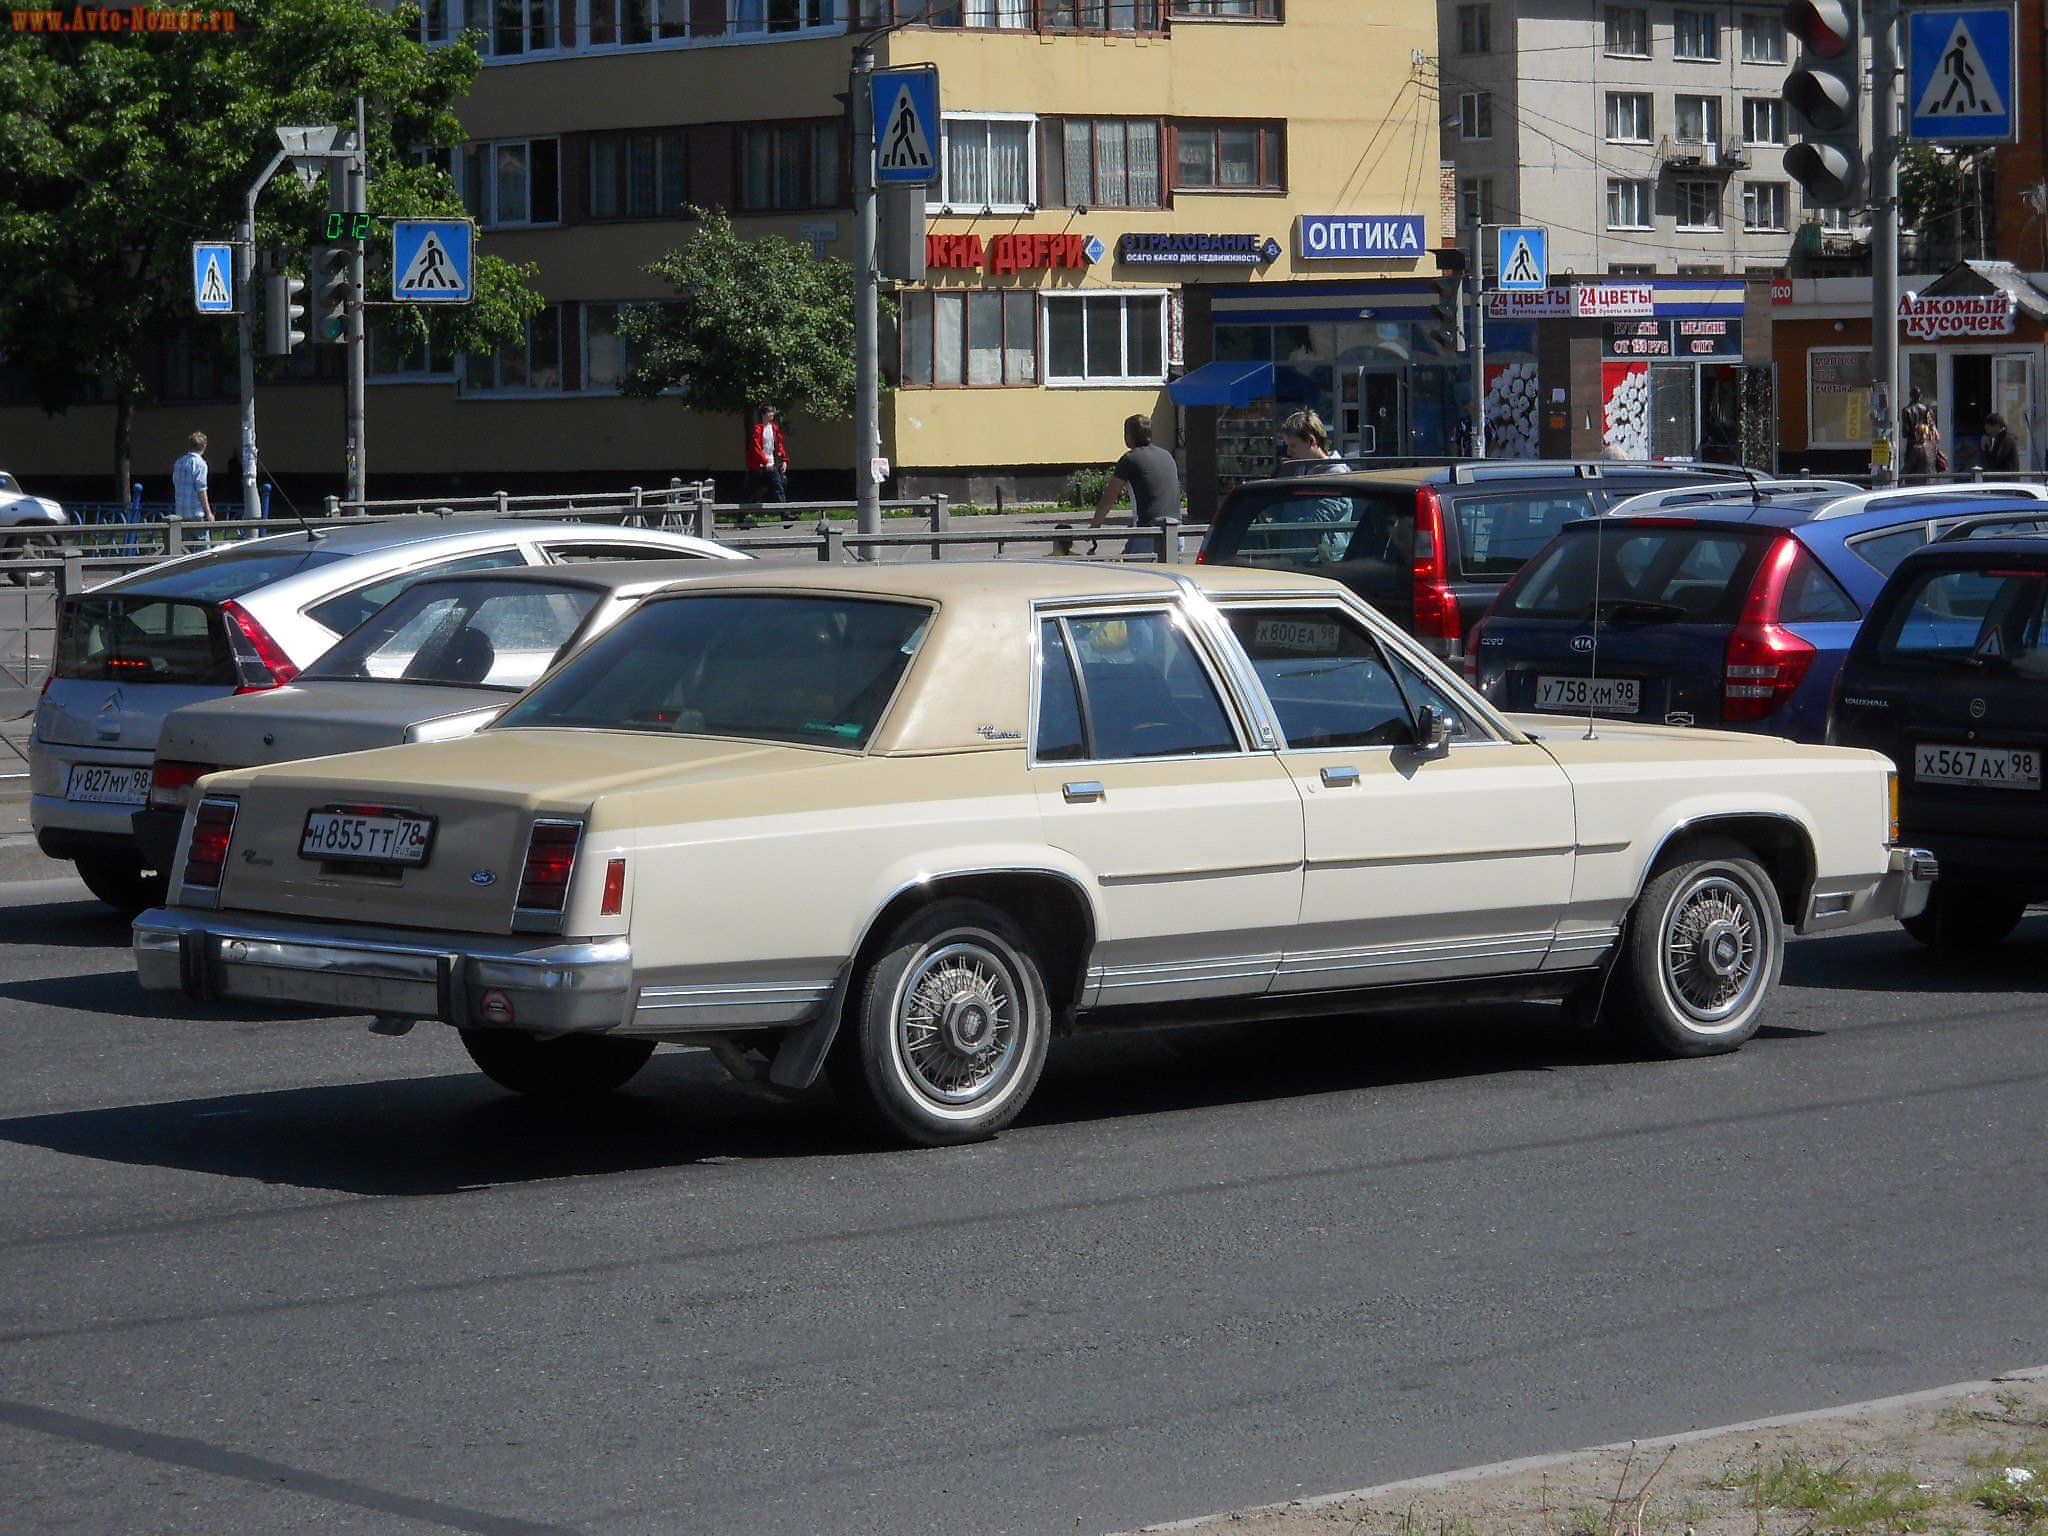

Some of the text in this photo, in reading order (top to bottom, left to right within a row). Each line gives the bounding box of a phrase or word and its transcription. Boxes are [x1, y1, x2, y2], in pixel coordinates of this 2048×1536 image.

[1122, 233, 1261, 251] СТРАХОВАНИЕ
[1308, 222, 1418, 250] ОПТИКА
[991, 234, 1083, 275] ДВЕРИ
[1126, 253, 1152, 262] ОСАГО
[1153, 253, 1179, 262] КАСКО
[1198, 253, 1261, 263] НЕДВИЖИМОСТЬ
[1512, 289, 1570, 308] ЦВЕТЫ
[1580, 288, 1652, 307] 24 ЦВЕТЫ
[1898, 293, 2008, 315] Лакомый
[1909, 315, 2006, 337] кусочек
[1321, 626, 1335, 639] 98
[1574, 639, 1592, 649] KIA
[1616, 682, 1634, 699] 98
[1924, 750, 2033, 779] Х567АХ 98
[74, 769, 149, 793] У827МУ 98
[311, 819, 421, 853] Н855ТТ 78
